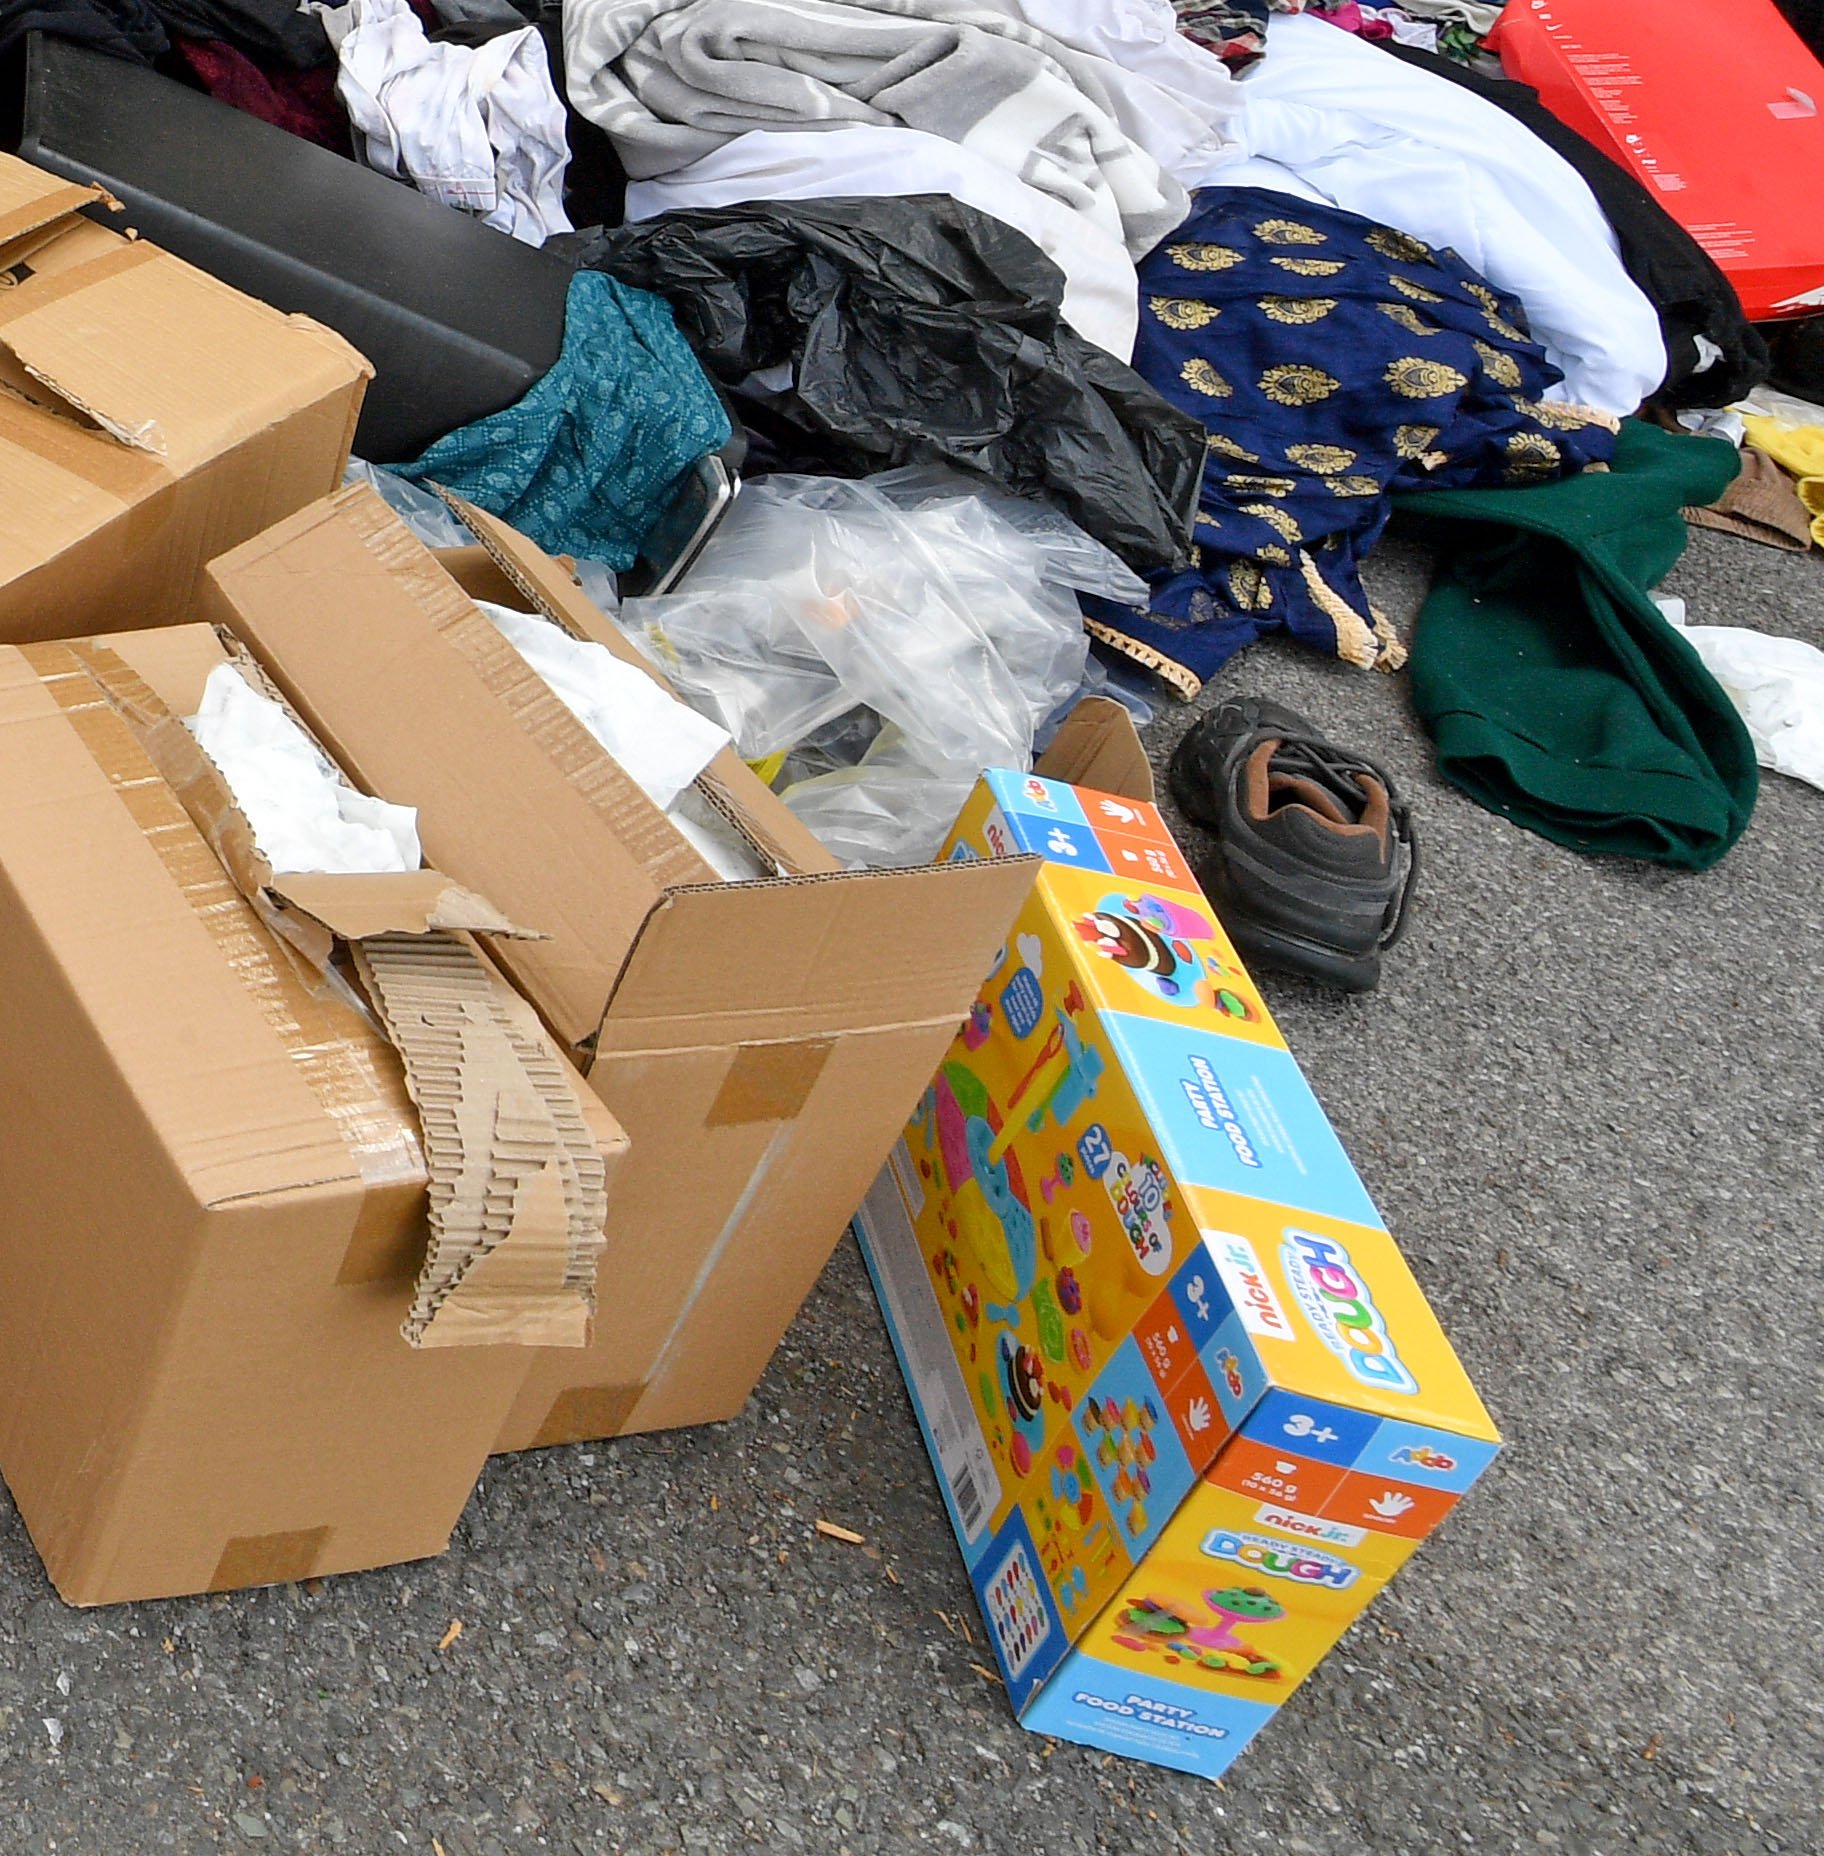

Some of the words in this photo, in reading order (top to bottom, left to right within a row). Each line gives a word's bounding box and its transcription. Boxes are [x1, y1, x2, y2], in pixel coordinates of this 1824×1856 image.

[1047, 828, 1078, 856] 3+
[1182, 1080, 1219, 1129] PARTY
[1190, 1056, 1234, 1121] STATION
[1084, 1126, 1111, 1164] 27
[1224, 1122, 1258, 1166] FOOD
[1116, 1162, 1151, 1232] COLOURS
[1139, 1172, 1160, 1212] 10
[1112, 1185, 1150, 1260] DOUGH
[1186, 1274, 1210, 1322] 3+
[1293, 1234, 1406, 1384] DOUGH
[1282, 1414, 1338, 1443] 3+
[1251, 1472, 1283, 1488] 560
[1284, 1484, 1298, 1494] g
[1214, 1534, 1353, 1585] DOUGH
[1242, 1534, 1289, 1549] READY
[1075, 1692, 1134, 1716] FOOD
[1138, 1711, 1225, 1738] STATION
[1126, 1695, 1193, 1718] PARTY
